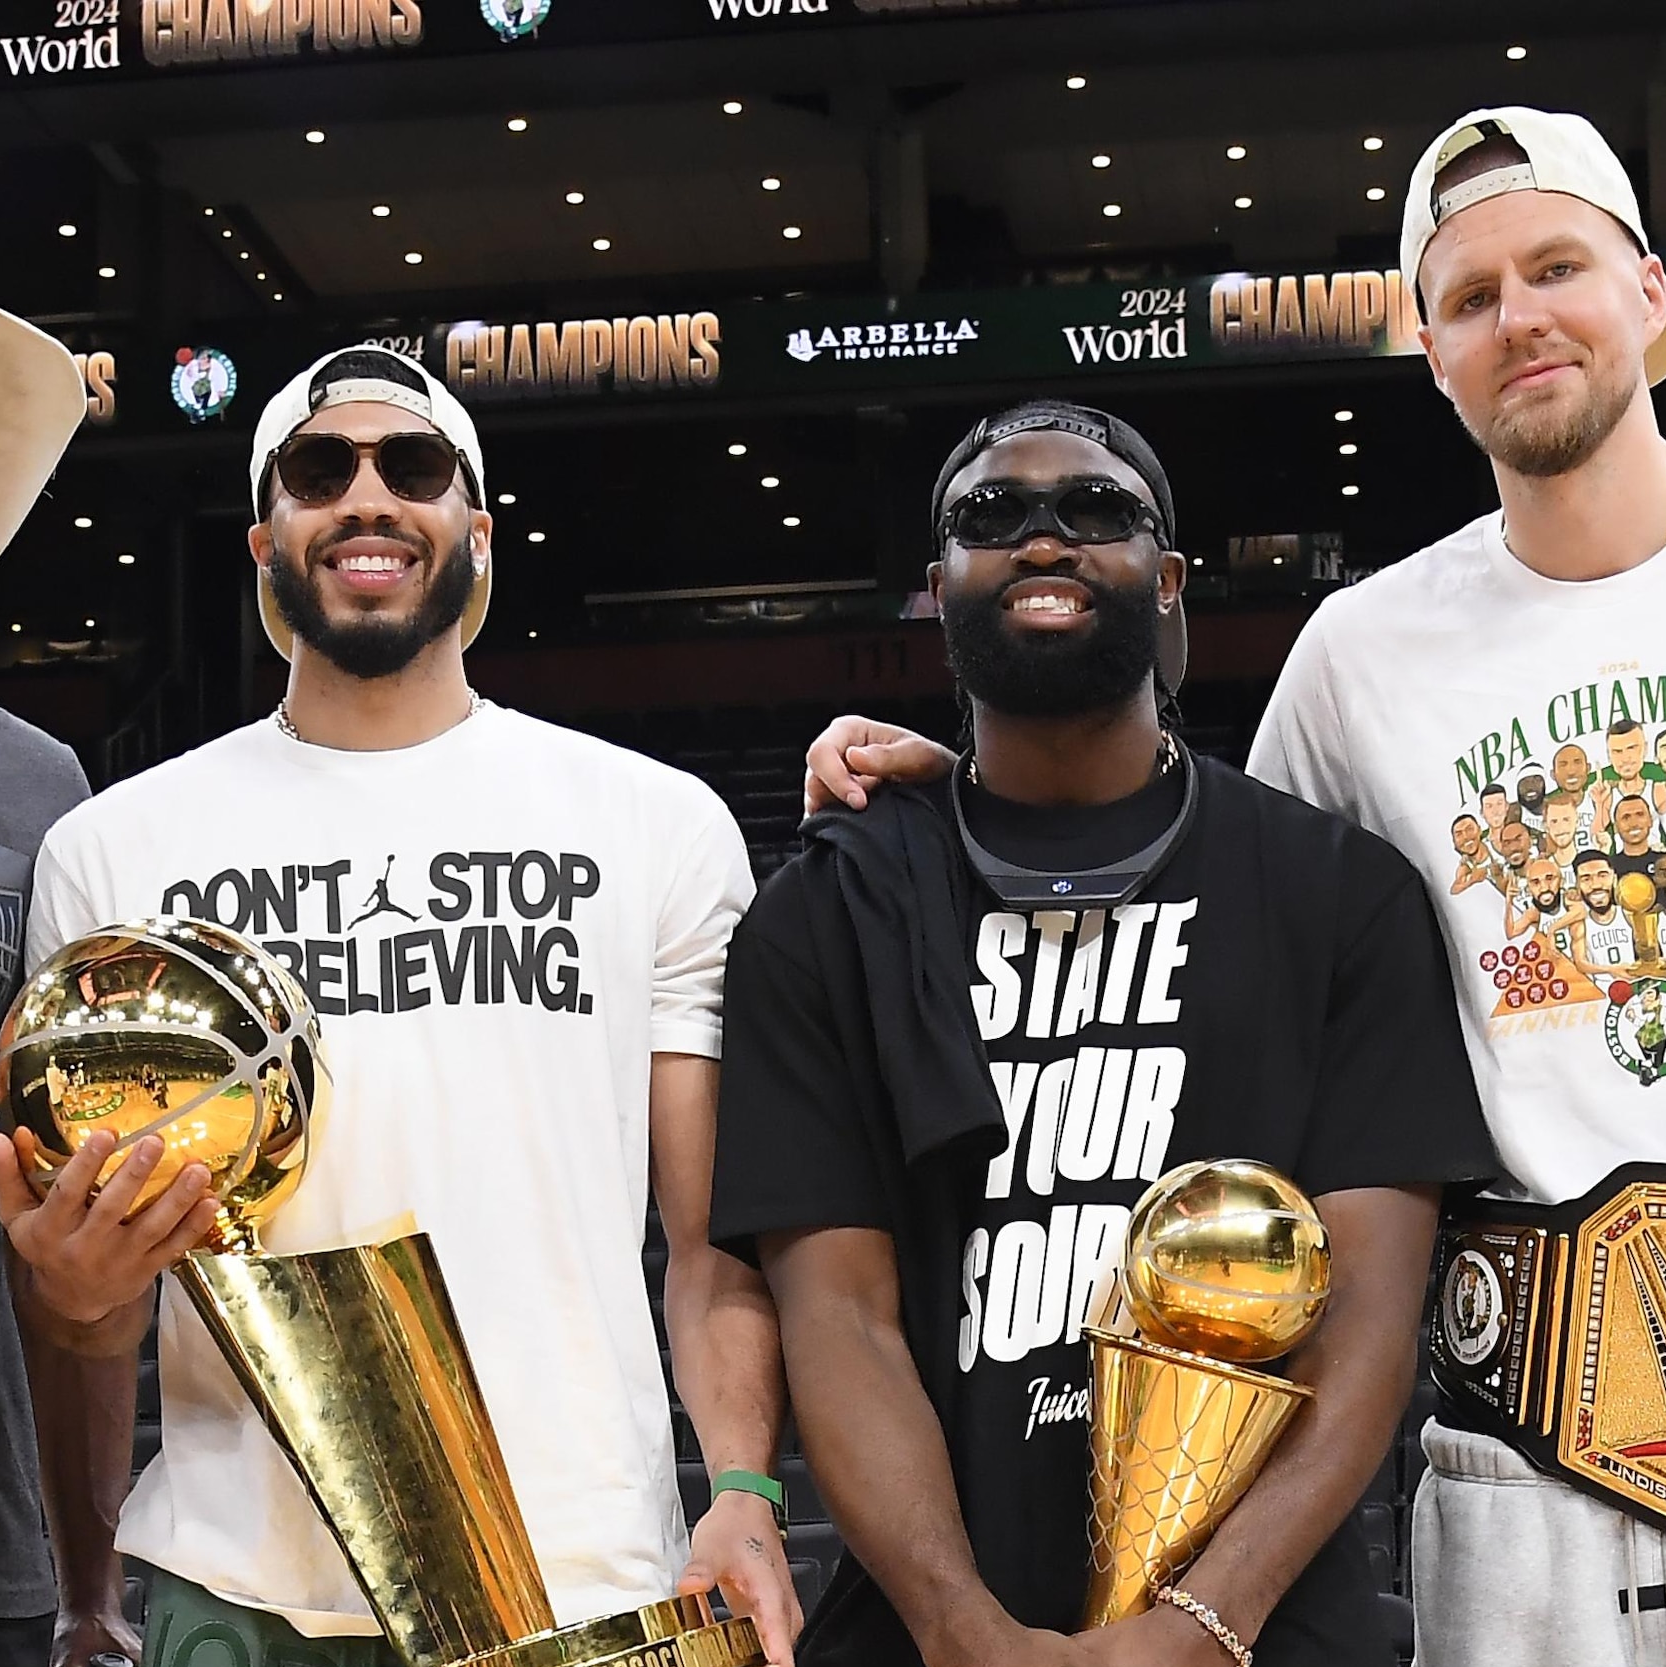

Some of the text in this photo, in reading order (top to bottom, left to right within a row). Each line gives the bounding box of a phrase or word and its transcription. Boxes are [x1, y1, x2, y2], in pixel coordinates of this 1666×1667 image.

[0, 28, 120, 76] World
[142, 0, 423, 69] CHAMPIONS
[816, 320, 979, 350] ARBELLA
[1120, 288, 1187, 319] 2024
[1209, 269, 1405, 348] CHAMPI
[444, 311, 721, 392] CHAMPIONS
[834, 339, 959, 361] INSURANCE
[1063, 316, 1187, 364] World
[1452, 716, 1534, 809] NBA
[161, 849, 601, 942] DON'T STOP
[969, 896, 1199, 1041] STATE
[1591, 927, 1630, 951] CELTICS
[1605, 1004, 1632, 1067] BOSTON
[985, 1045, 1187, 1199] YOUR
